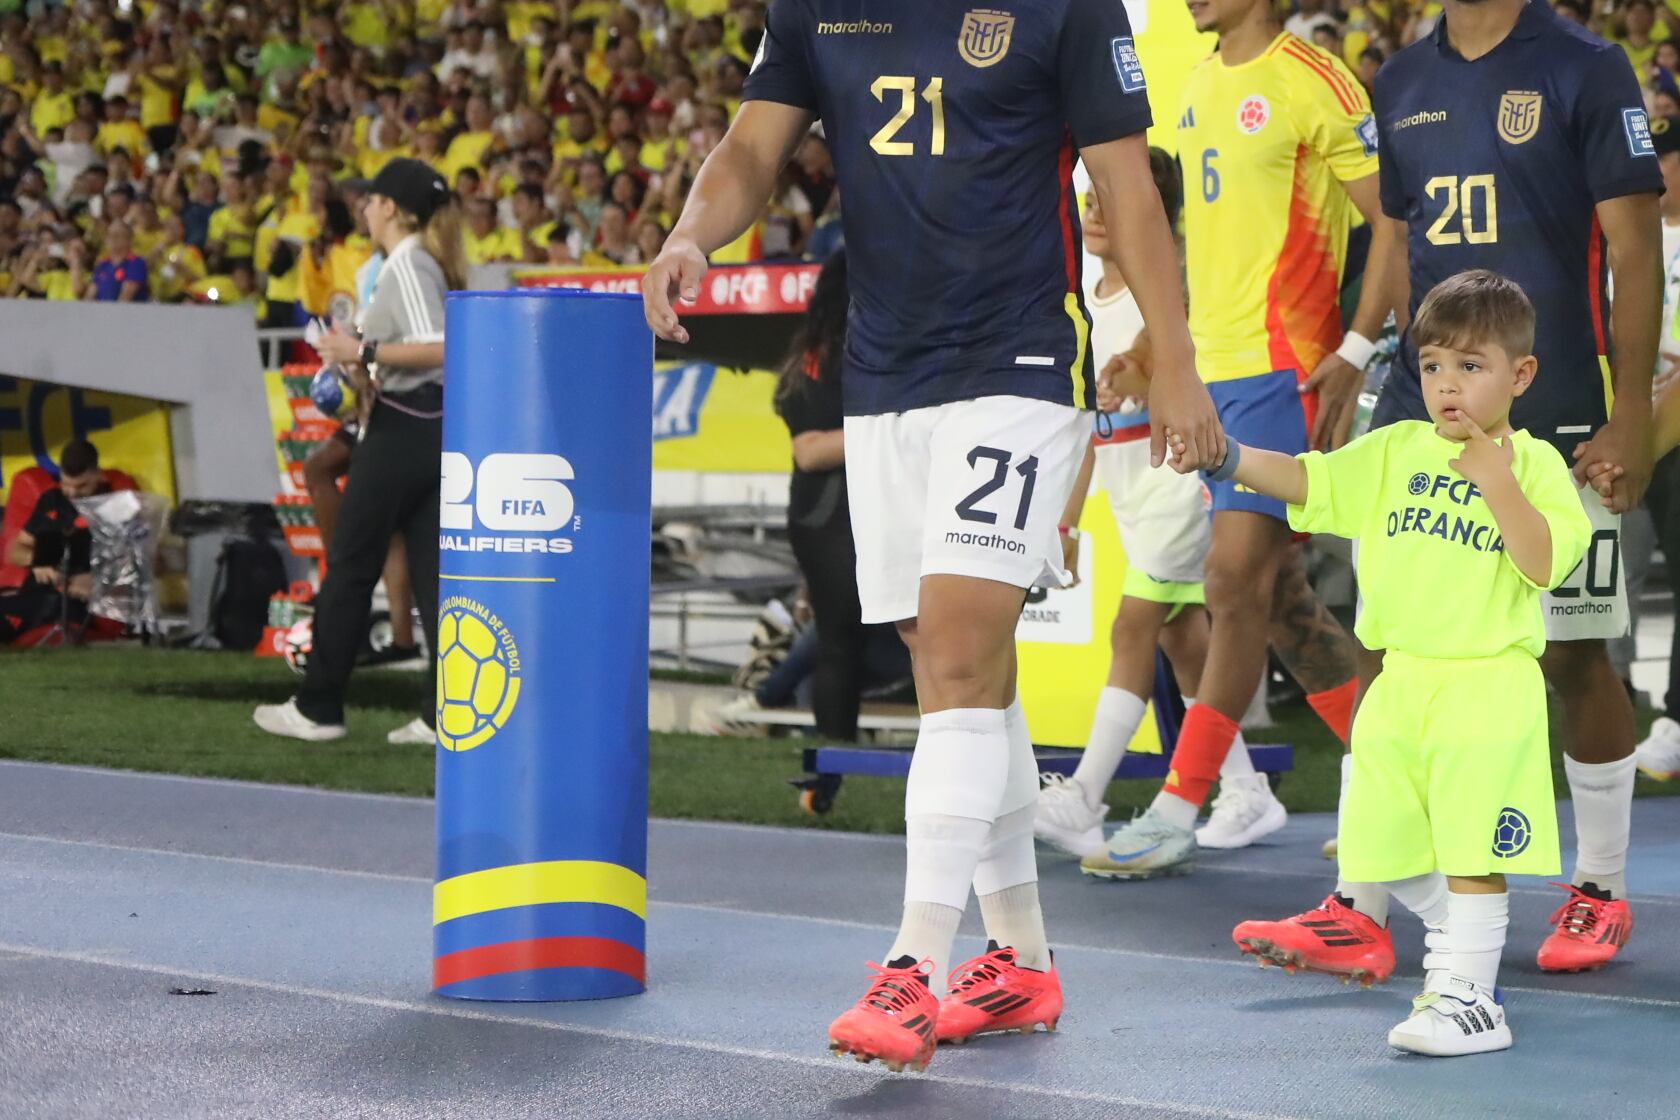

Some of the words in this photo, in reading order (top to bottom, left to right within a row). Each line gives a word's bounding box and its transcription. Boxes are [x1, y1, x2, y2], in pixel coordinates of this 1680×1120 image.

[817, 20, 893, 35] marathon
[869, 76, 945, 155] 21
[1393, 110, 1447, 132] marathon
[1202, 148, 1220, 204] 6
[1424, 174, 1497, 245] 20
[955, 445, 1039, 530] 21
[1430, 474, 1482, 506] FCF
[501, 499, 546, 516] FIFA
[945, 532, 1026, 554] marathon
[1551, 601, 1612, 616] marathon
[488, 614, 503, 631] DE
[498, 628, 520, 674] FÚTBOL
